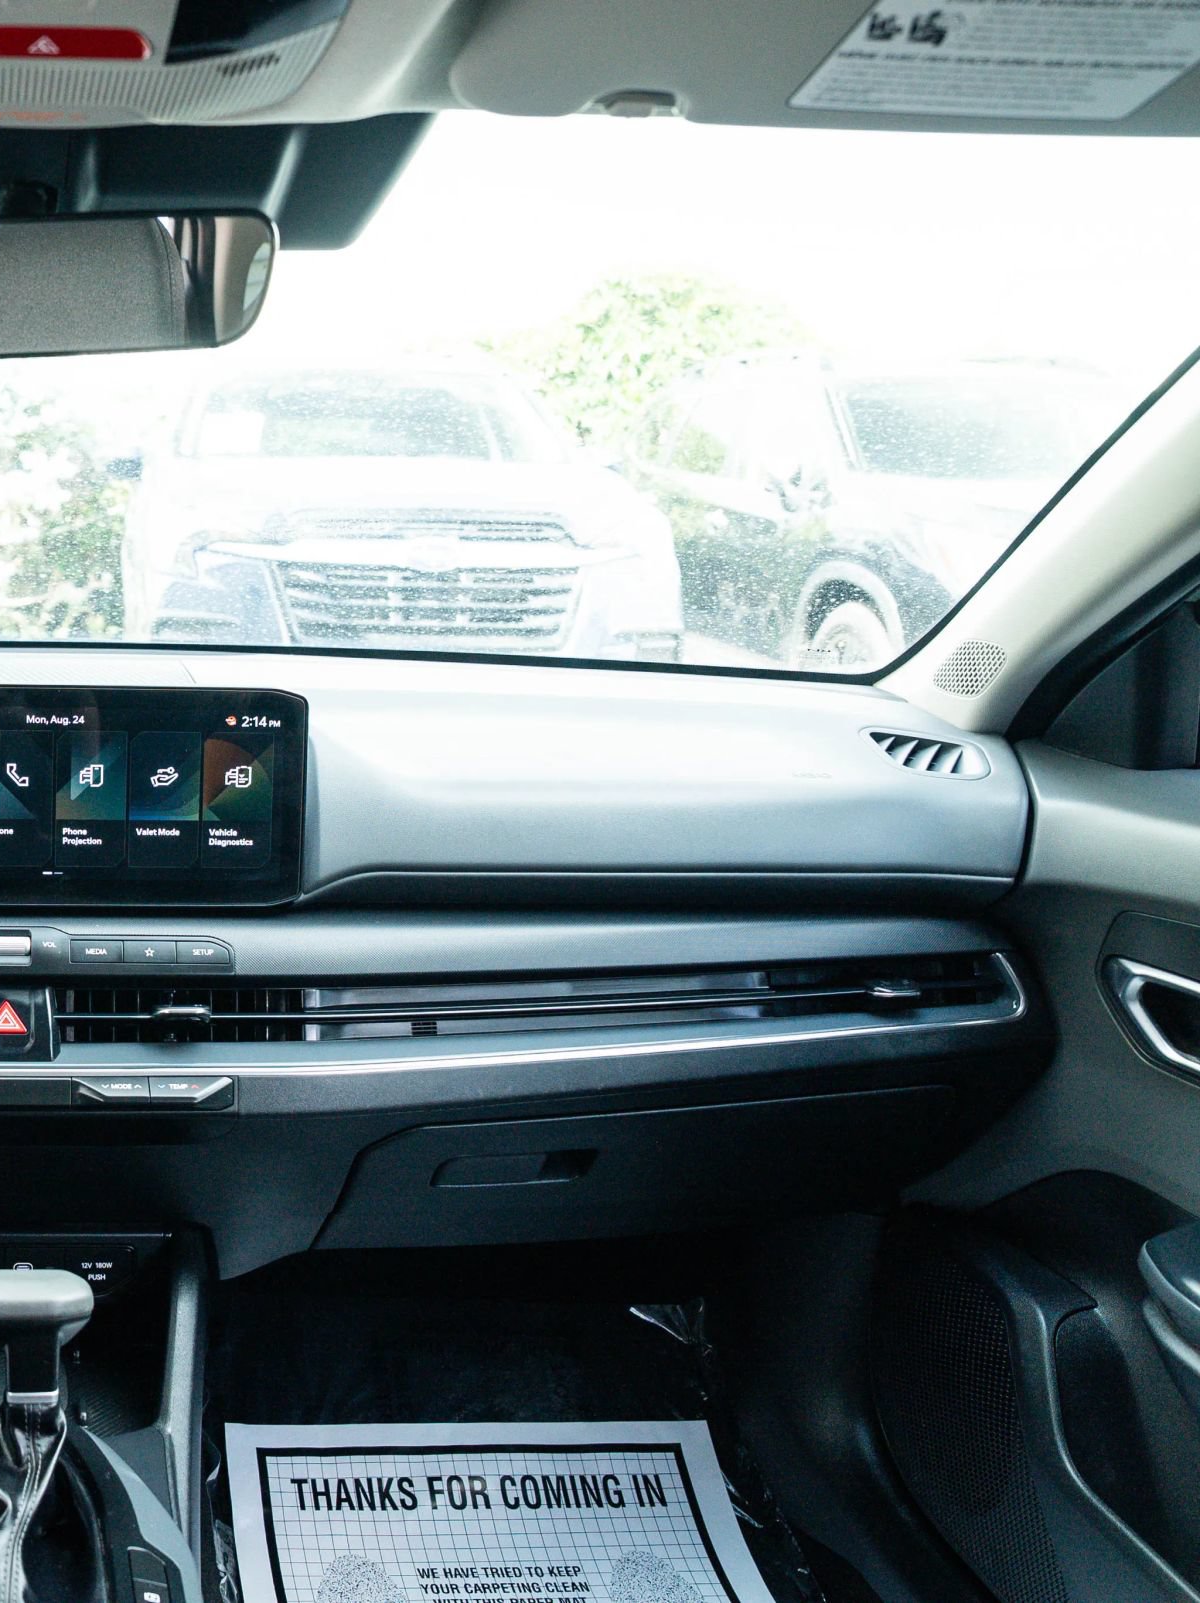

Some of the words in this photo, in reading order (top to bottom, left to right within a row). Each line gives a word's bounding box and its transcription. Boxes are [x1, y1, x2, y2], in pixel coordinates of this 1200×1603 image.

[26, 715, 48, 725] Mon,
[50, 715, 71, 726] Aug.
[72, 715, 85, 724] 24
[241, 716, 267, 728] 2:14
[269, 720, 280, 728] PM
[62, 828, 87, 836] Phone
[136, 828, 157, 836] Valet
[158, 828, 180, 836] Mode
[62, 837, 102, 846] Projection
[209, 838, 254, 847] Diagnostics
[86, 948, 108, 956] MEDIA
[290, 1477, 418, 1512] THANKS
[427, 1476, 492, 1511] FOR
[500, 1474, 626, 1510] COMING
[633, 1474, 668, 1508] IN
[417, 1568, 440, 1579] WE
[443, 1568, 480, 1578] HAVE
[481, 1567, 523, 1578] TRIED
[527, 1567, 544, 1578] TO
[548, 1566, 581, 1577] KEEP
[420, 1584, 460, 1594] YOUR
[464, 1583, 542, 1594] CARPETING
[545, 1582, 590, 1593] CLEAN
